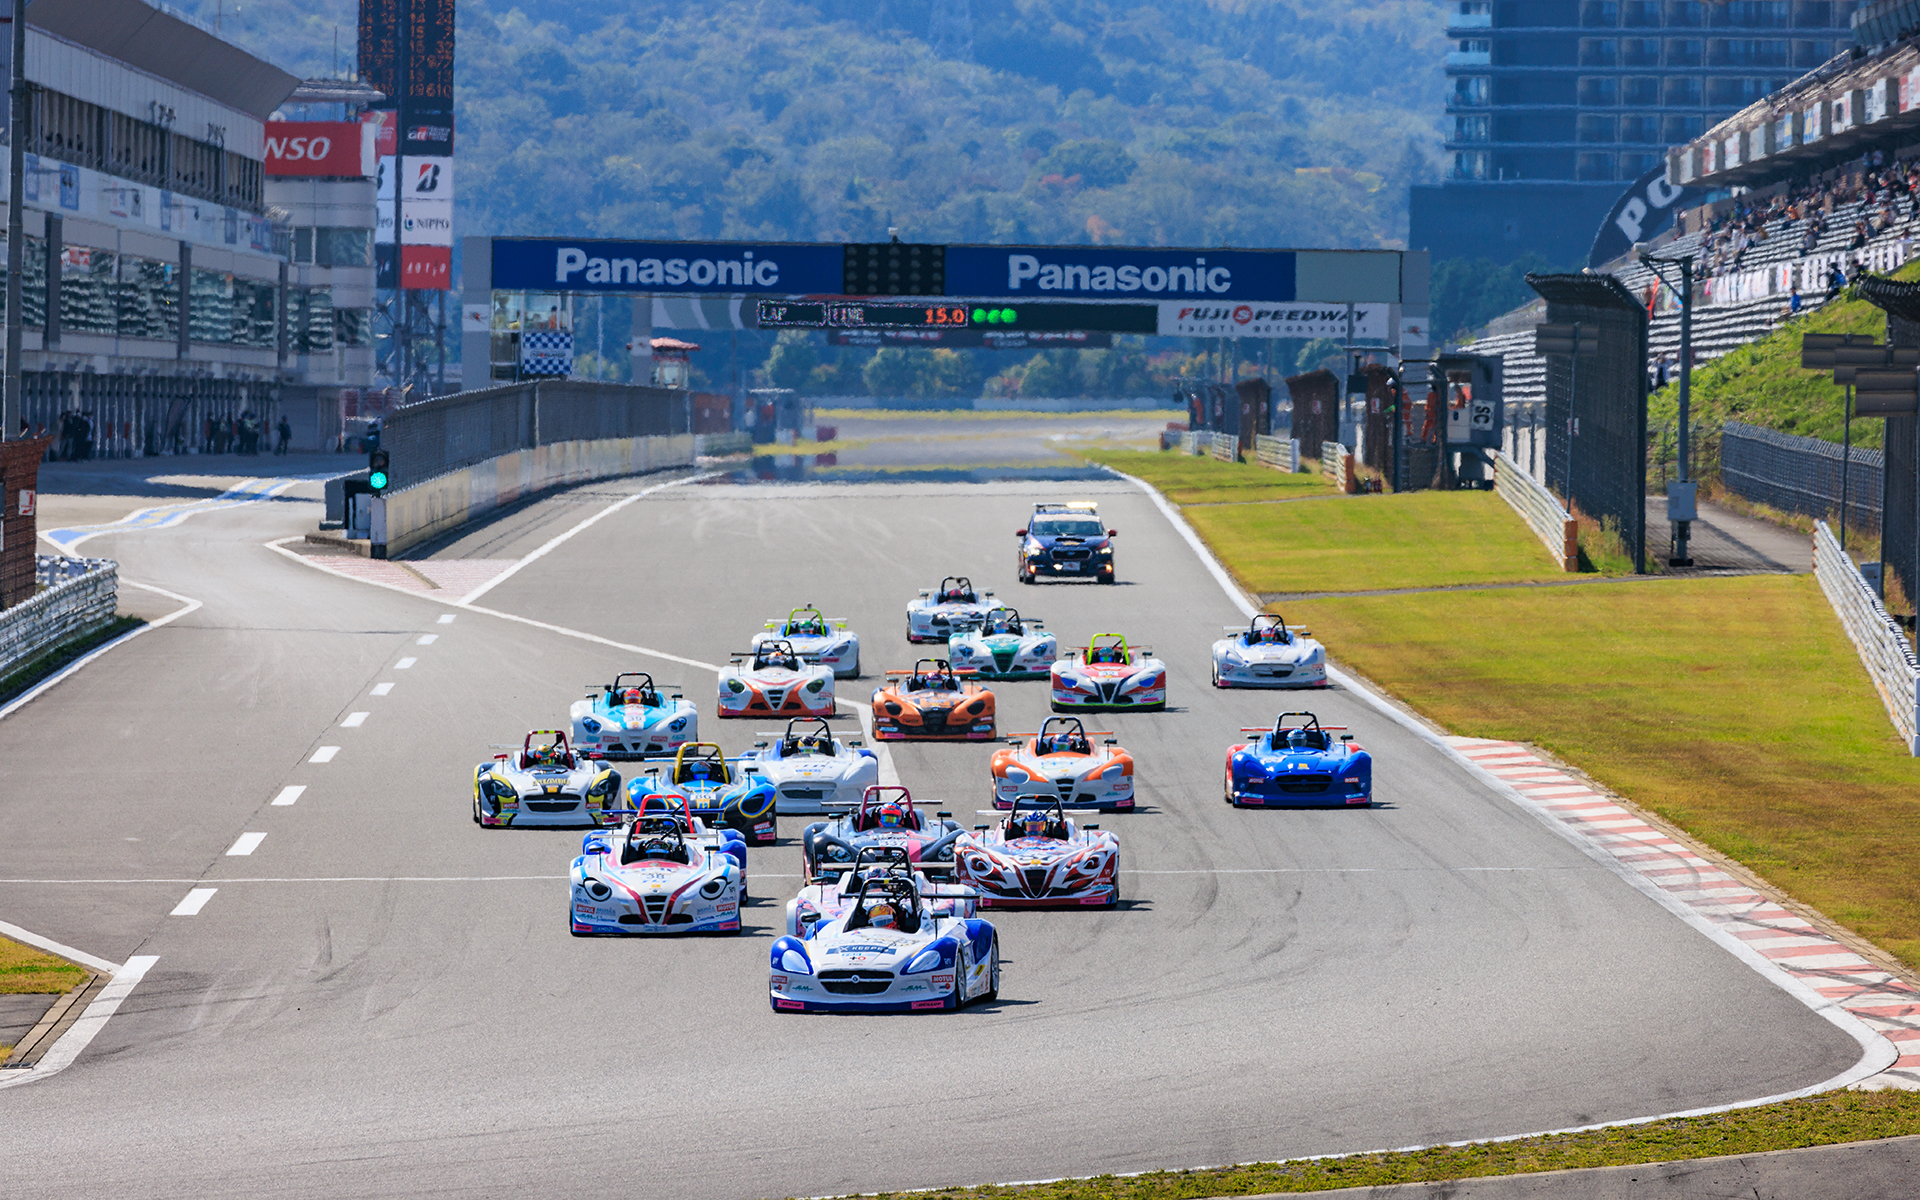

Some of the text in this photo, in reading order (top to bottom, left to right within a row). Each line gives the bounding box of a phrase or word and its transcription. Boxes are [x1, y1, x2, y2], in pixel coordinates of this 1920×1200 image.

[264, 136, 330, 161] NSO
[1615, 174, 1684, 243] PO
[417, 218, 449, 230] NIPPO
[556, 247, 779, 286] Panasonic
[1008, 254, 1232, 293] Panasonic
[762, 305, 787, 321] LAP
[925, 307, 965, 323] 15.0
[1178, 305, 1368, 325] FUJI SPEEDWAY
[1253, 325, 1367, 334] MOTORSPORS
[932, 975, 954, 983] MOTUL
